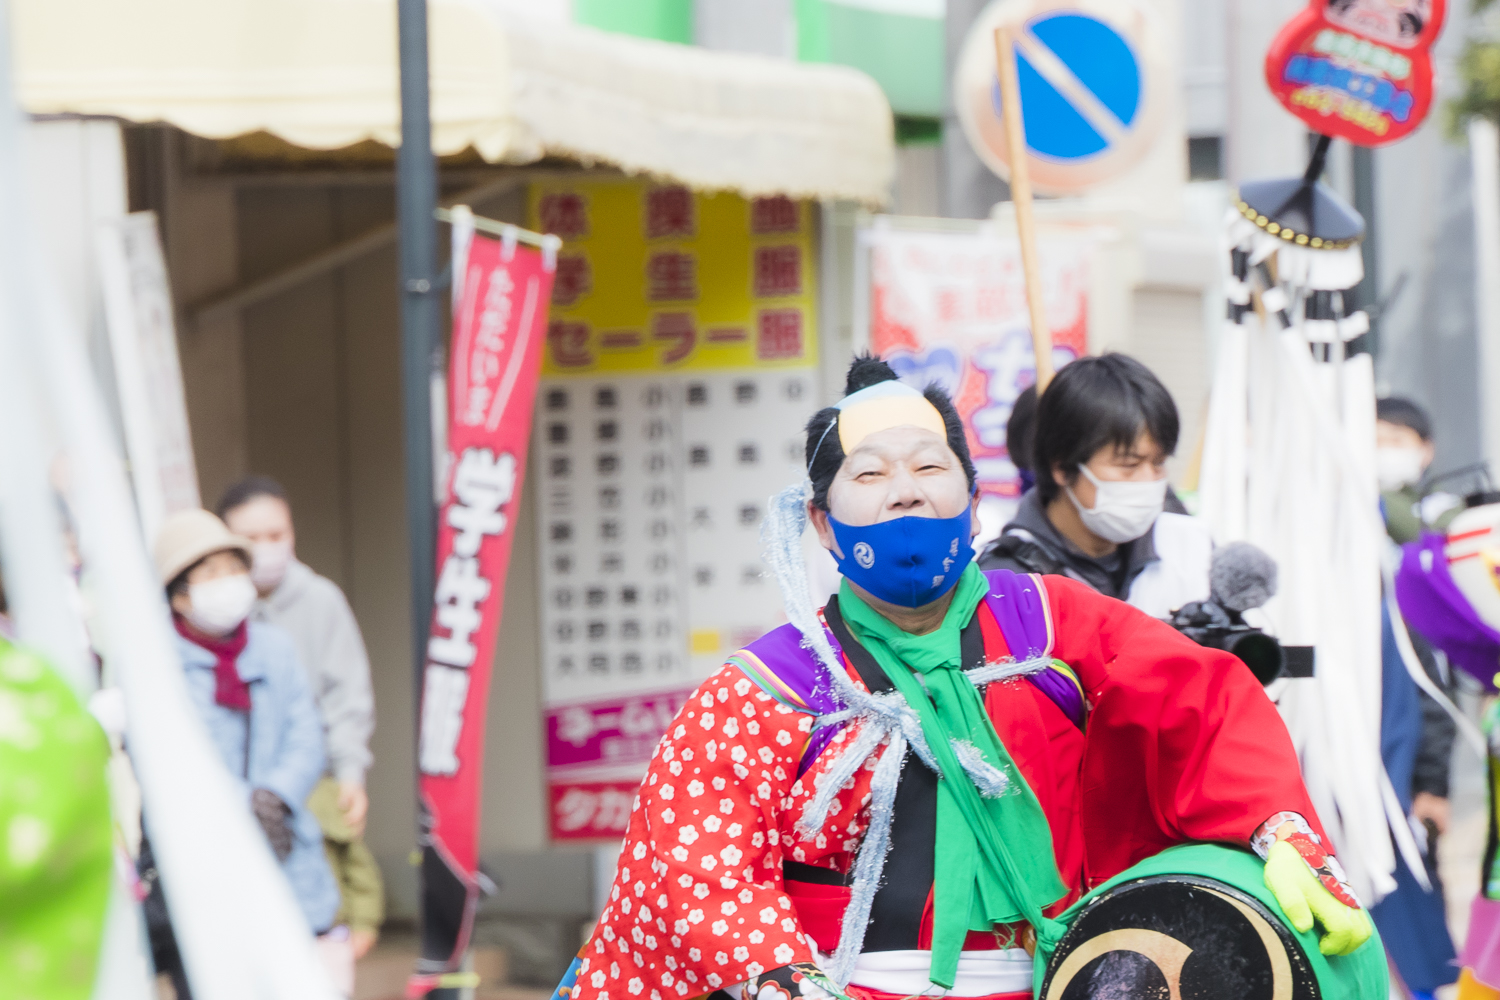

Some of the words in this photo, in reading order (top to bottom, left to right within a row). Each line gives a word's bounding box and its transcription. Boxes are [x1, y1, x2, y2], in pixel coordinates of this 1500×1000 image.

[547, 308, 804, 367] セーラー服
[418, 446, 516, 776] 学生服
[554, 786, 640, 832] タカ
